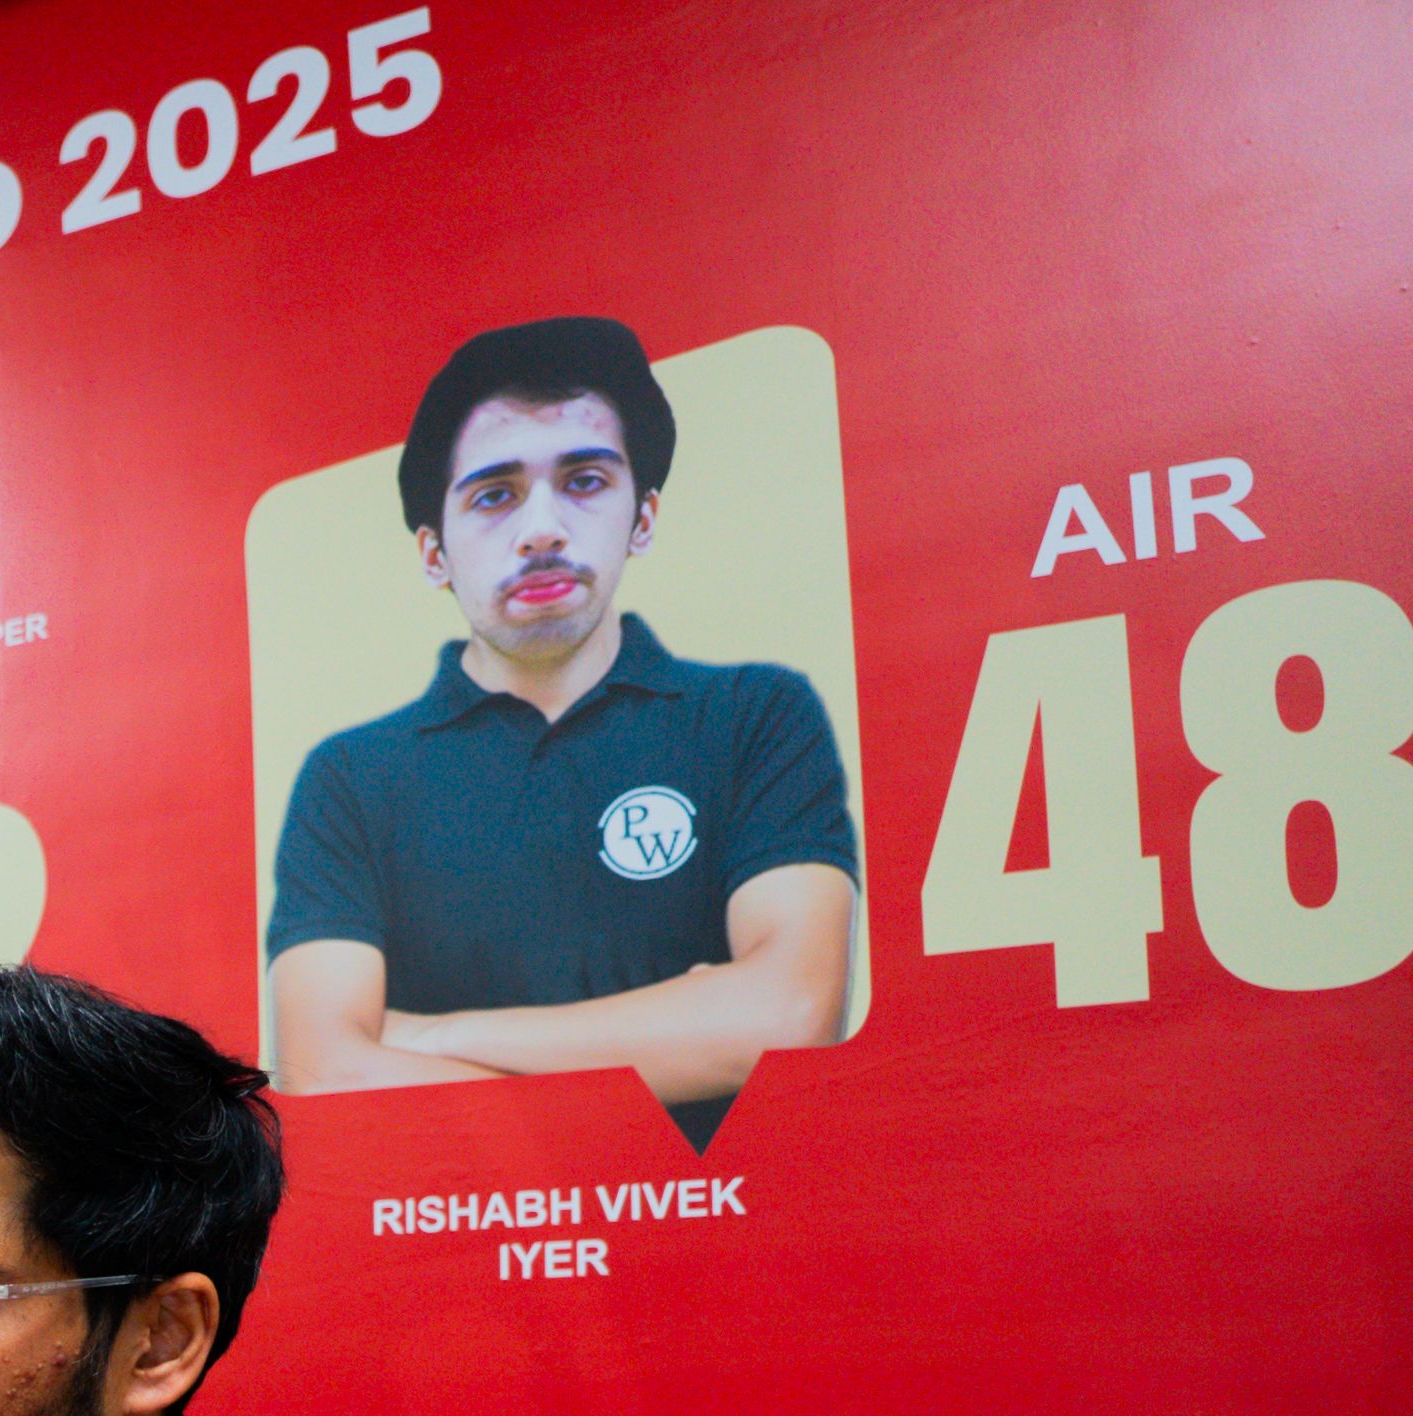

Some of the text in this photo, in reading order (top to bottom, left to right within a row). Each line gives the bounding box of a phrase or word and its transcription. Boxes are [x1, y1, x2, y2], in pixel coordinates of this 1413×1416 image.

[59, 6, 443, 235] 2025
[1030, 456, 1266, 578] AIR
[920, 579, 1413, 1009] 48
[372, 1176, 747, 1236] RISHABH VIVEK
[499, 1238, 610, 1281] IYER
